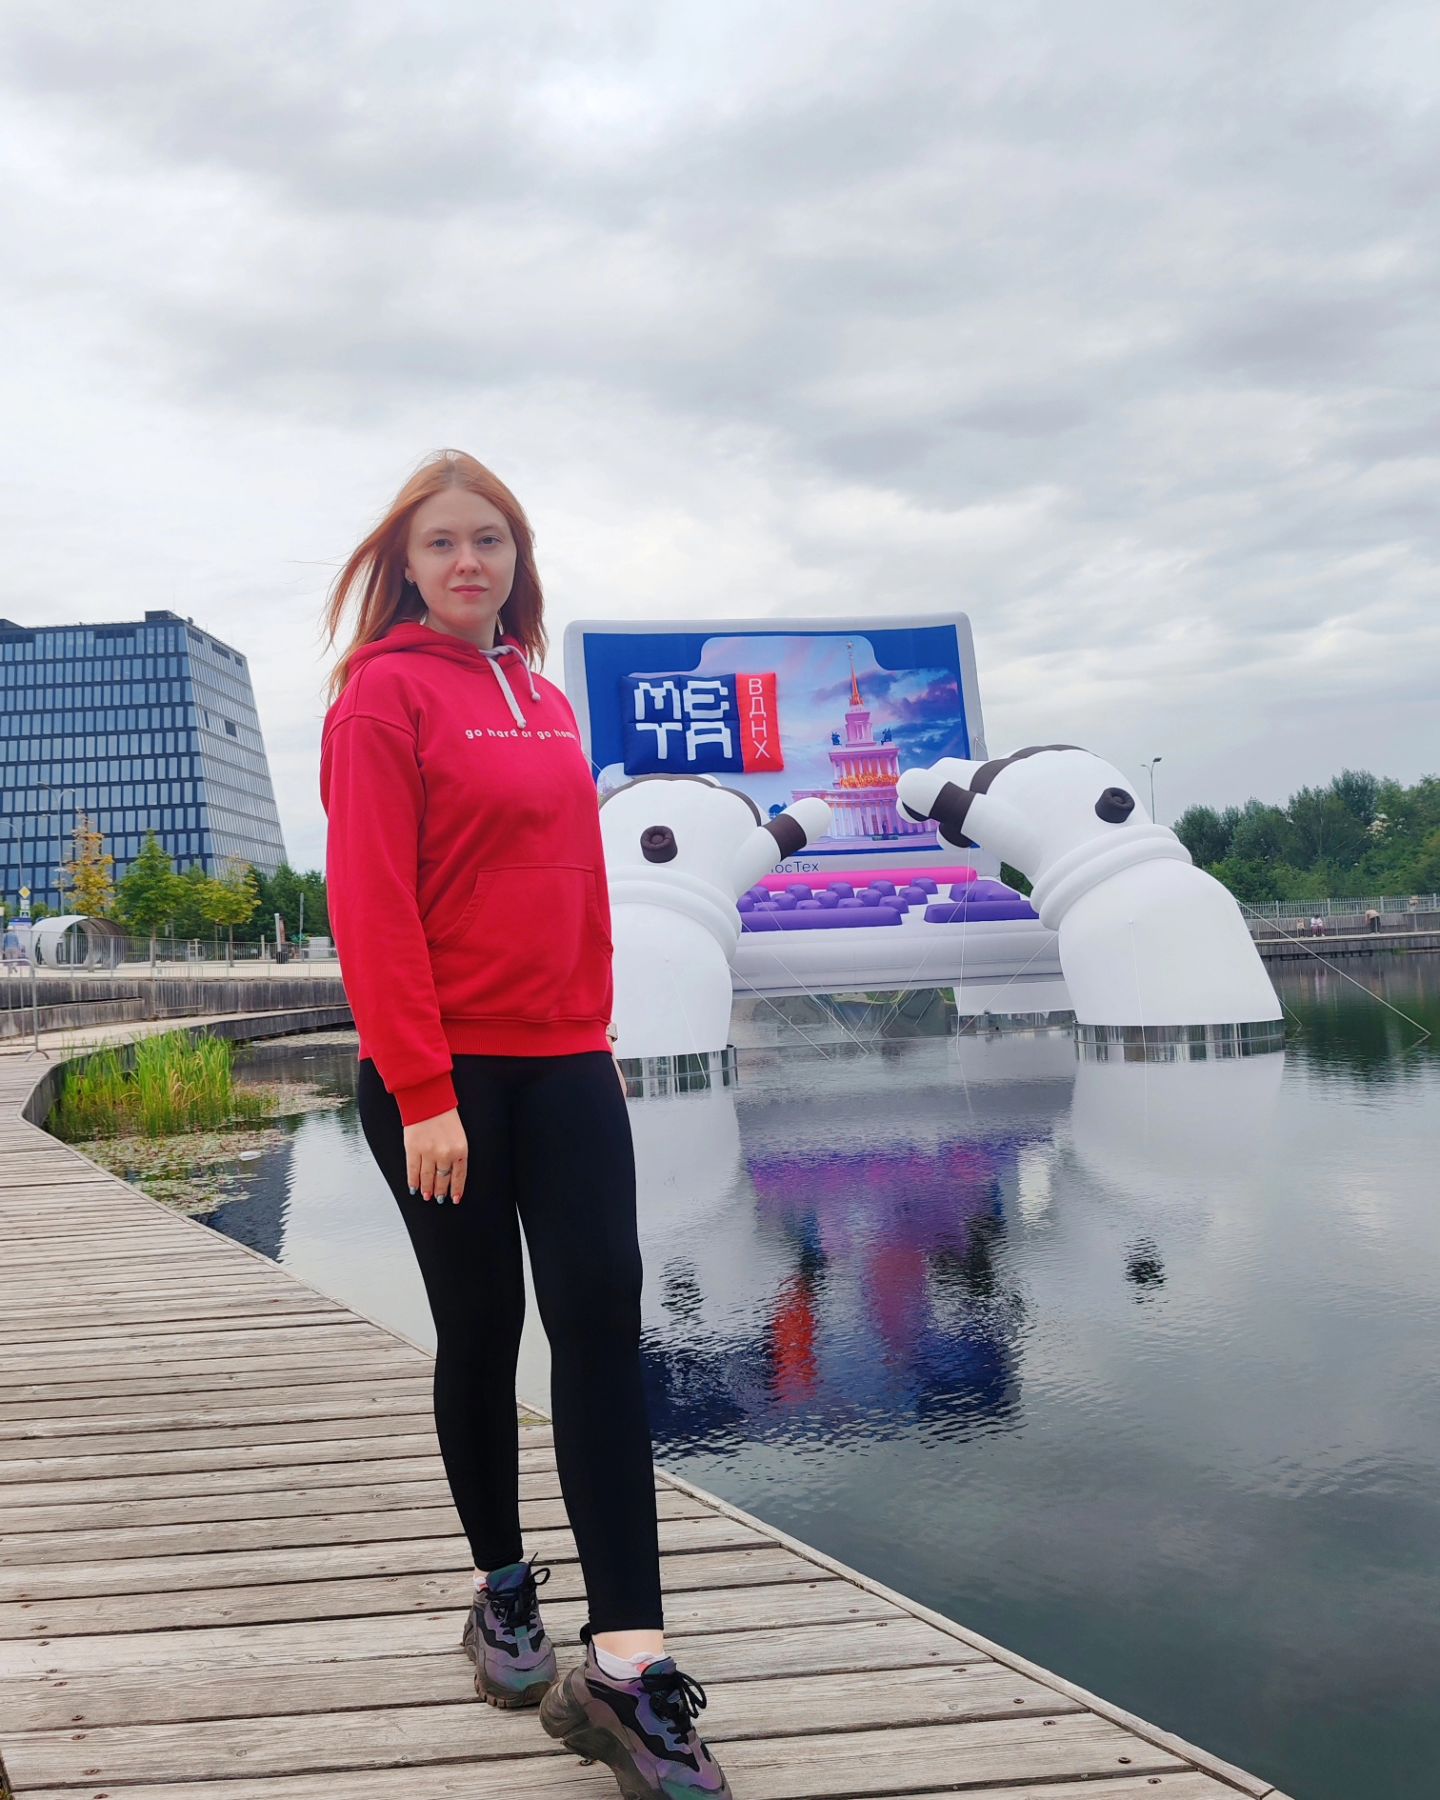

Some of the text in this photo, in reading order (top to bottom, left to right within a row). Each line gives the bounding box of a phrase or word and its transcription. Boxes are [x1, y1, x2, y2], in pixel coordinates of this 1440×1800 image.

[748, 678, 770, 759] ВДНХ
[465, 728, 577, 740] go hard or go hom
[770, 861, 819, 874] осТех
